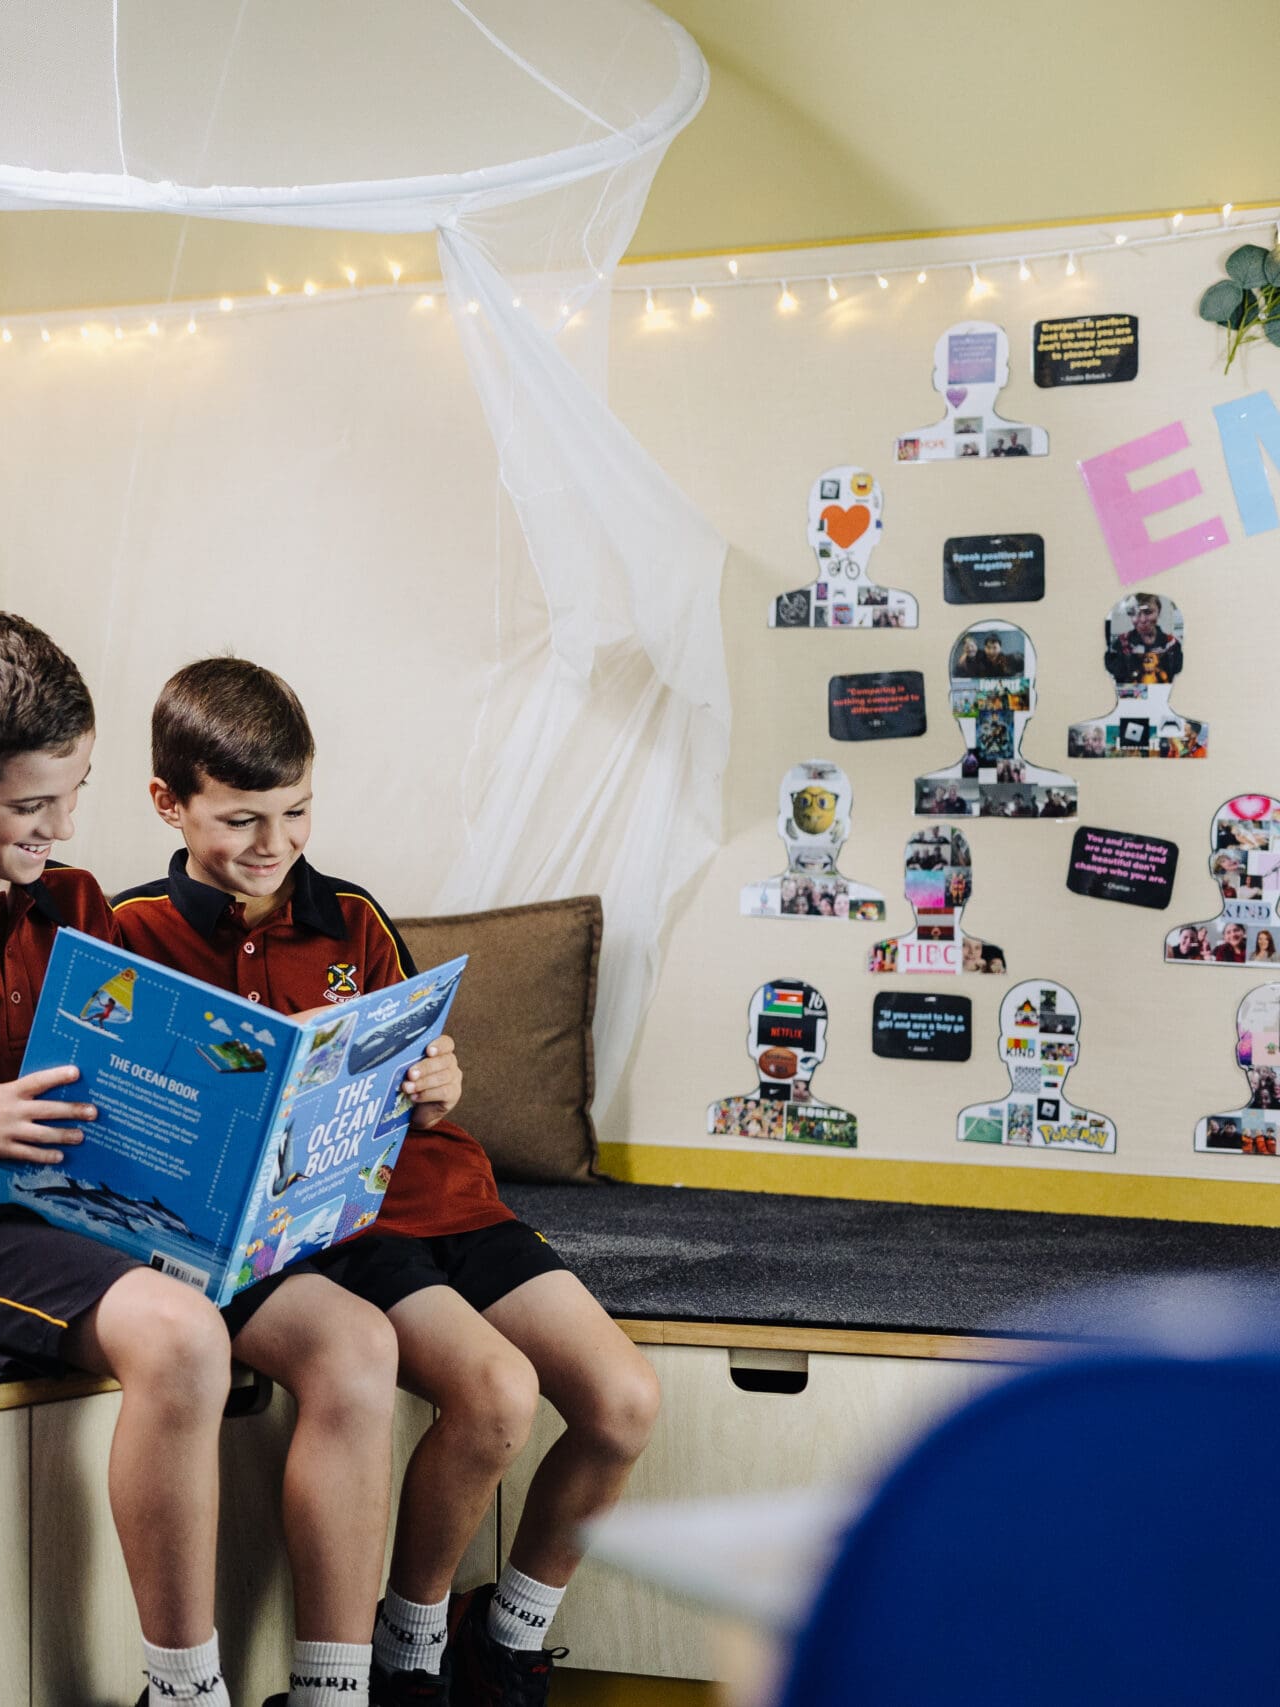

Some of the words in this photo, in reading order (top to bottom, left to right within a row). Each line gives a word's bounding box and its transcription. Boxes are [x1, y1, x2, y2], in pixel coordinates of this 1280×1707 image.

[1041, 322, 1085, 333] Everyone
[1095, 316, 1130, 328] perfect
[1040, 333, 1058, 344] just
[1059, 332, 1075, 340] the
[1076, 330, 1096, 339] way
[1097, 329, 1114, 338] you
[1114, 327, 1131, 335] are
[1061, 340, 1096, 350] change
[1097, 335, 1134, 348] yourself
[1051, 352, 1062, 360] to
[1063, 350, 1094, 361] please
[1094, 347, 1120, 356] other
[1070, 358, 1102, 369] people
[952, 552, 981, 563] Speak
[981, 551, 1018, 562] positive
[1017, 550, 1034, 559] not
[973, 561, 1013, 572] negative
[1086, 832, 1104, 843] You
[1105, 837, 1123, 846] and
[1123, 840, 1144, 850] your
[1145, 843, 1168, 856] body
[1084, 844, 1100, 852] are
[1101, 847, 1113, 855] so
[1114, 848, 1148, 861] special
[1148, 855, 1167, 864] and
[1091, 854, 1132, 868] beautiful
[1074, 861, 1108, 874] change
[1109, 868, 1129, 877] who
[1130, 871, 1147, 881] you
[892, 1012, 909, 1021] you
[909, 1012, 932, 1020] want
[933, 1013, 943, 1022] to
[943, 1012, 956, 1022] be
[770, 1026, 803, 1038] NETFLIX
[878, 1020, 893, 1030] girl
[894, 1021, 911, 1029] and
[912, 1022, 928, 1030] are
[936, 1022, 953, 1033] boy
[953, 1024, 966, 1033] go
[907, 1030, 920, 1039] for
[1006, 1047, 1036, 1059] KIND
[109, 1053, 131, 1074] THE
[131, 1063, 168, 1089] OCEAN
[167, 1079, 200, 1102] BOOK
[334, 1072, 378, 1115] THE
[797, 1106, 848, 1121] ROBLOX
[307, 1097, 381, 1153] OCEAN
[304, 1130, 365, 1178] BOOK
